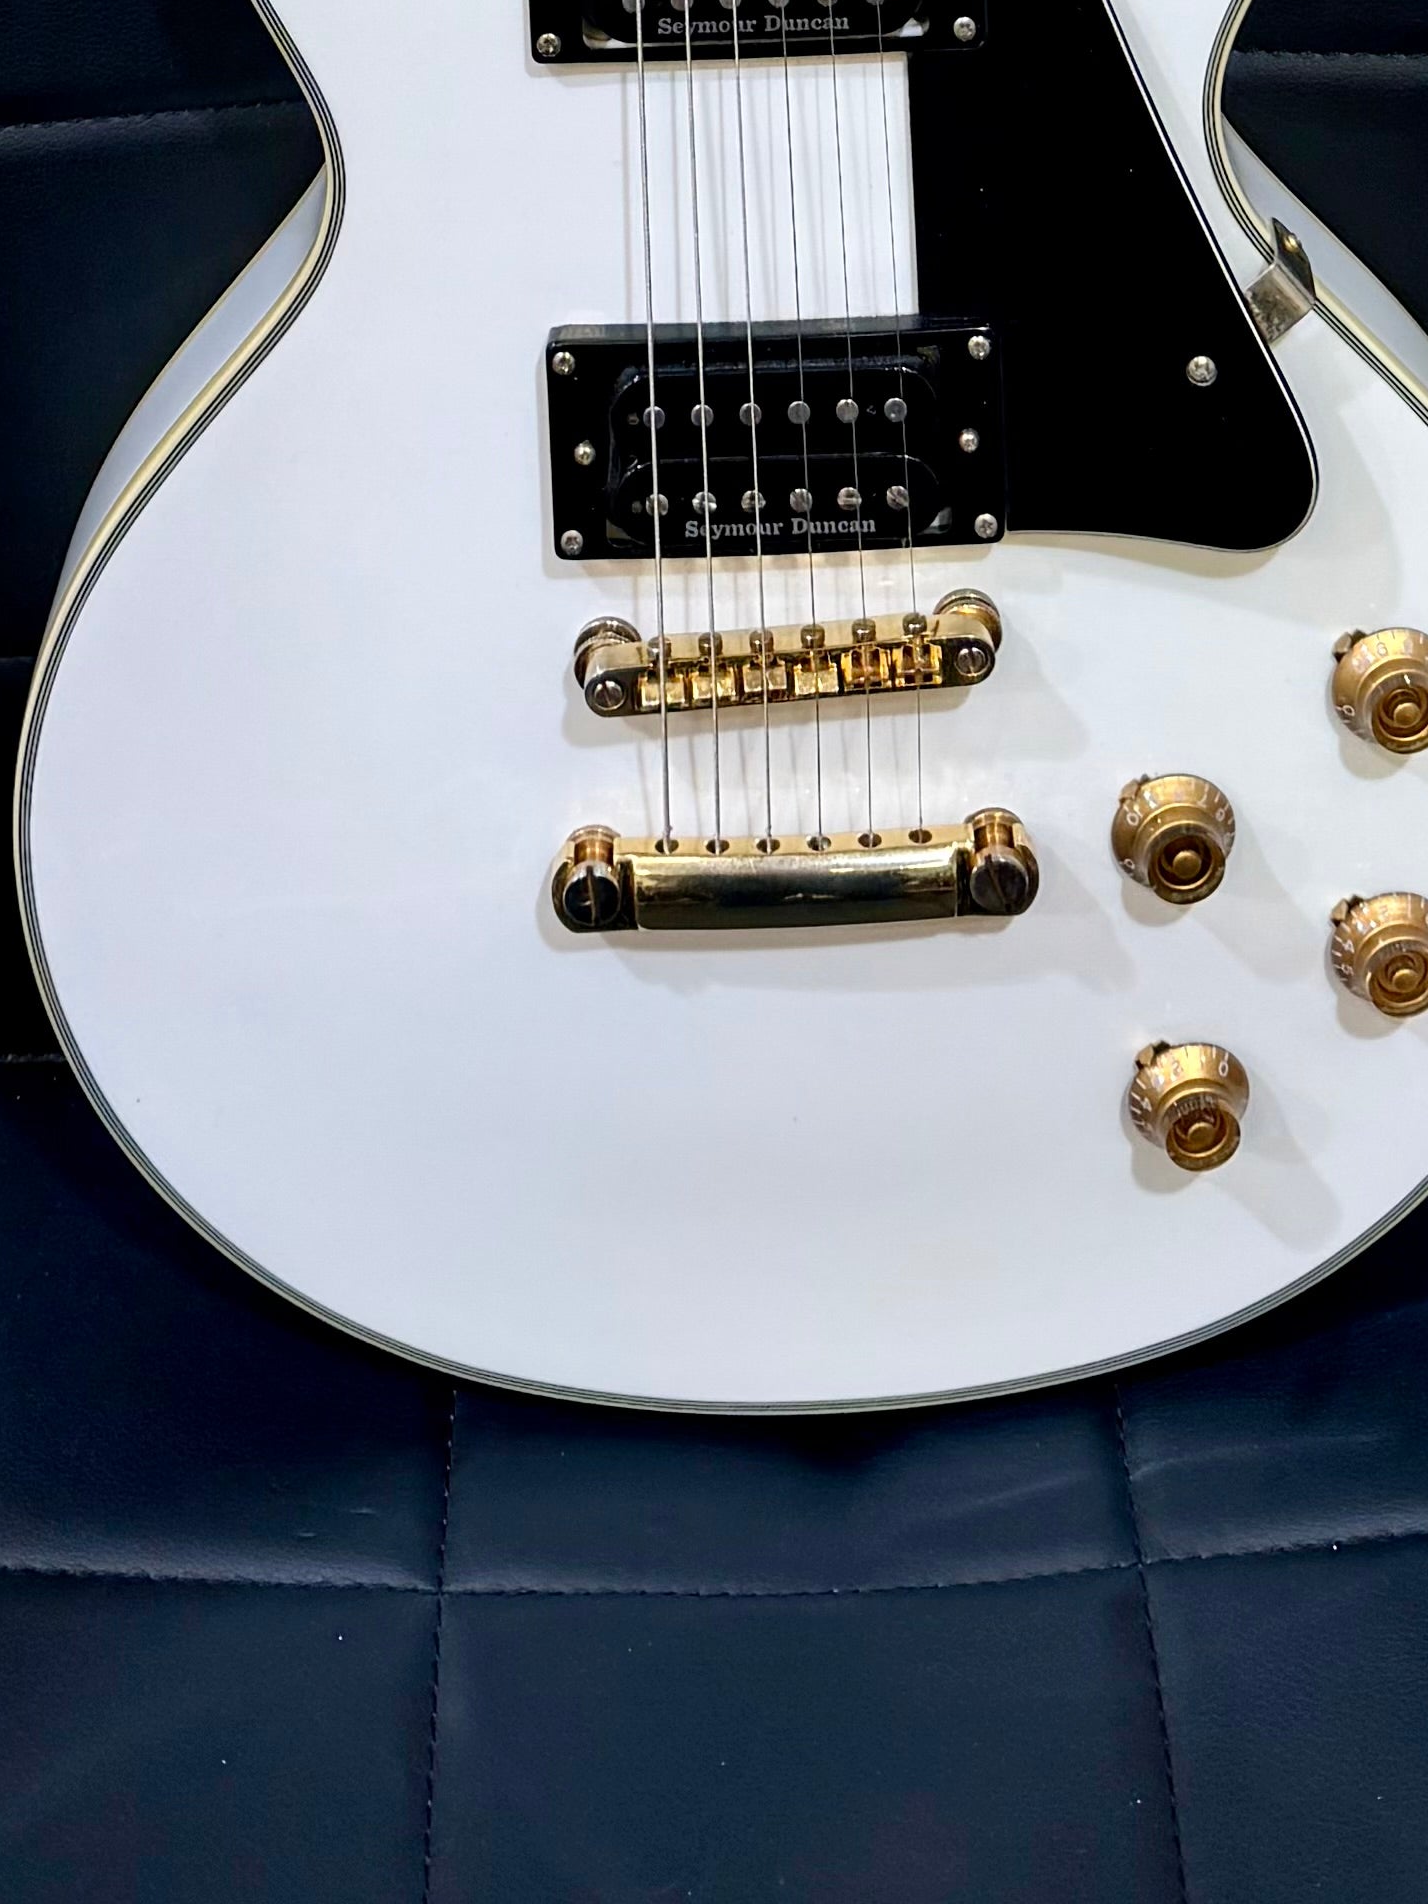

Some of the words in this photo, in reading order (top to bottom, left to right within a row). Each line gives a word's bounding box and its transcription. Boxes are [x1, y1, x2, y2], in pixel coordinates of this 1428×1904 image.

[658, 17, 756, 36] Seymour
[764, 15, 850, 32] Duncan
[685, 520, 783, 540] Seymour
[791, 517, 876, 535] Duncan
